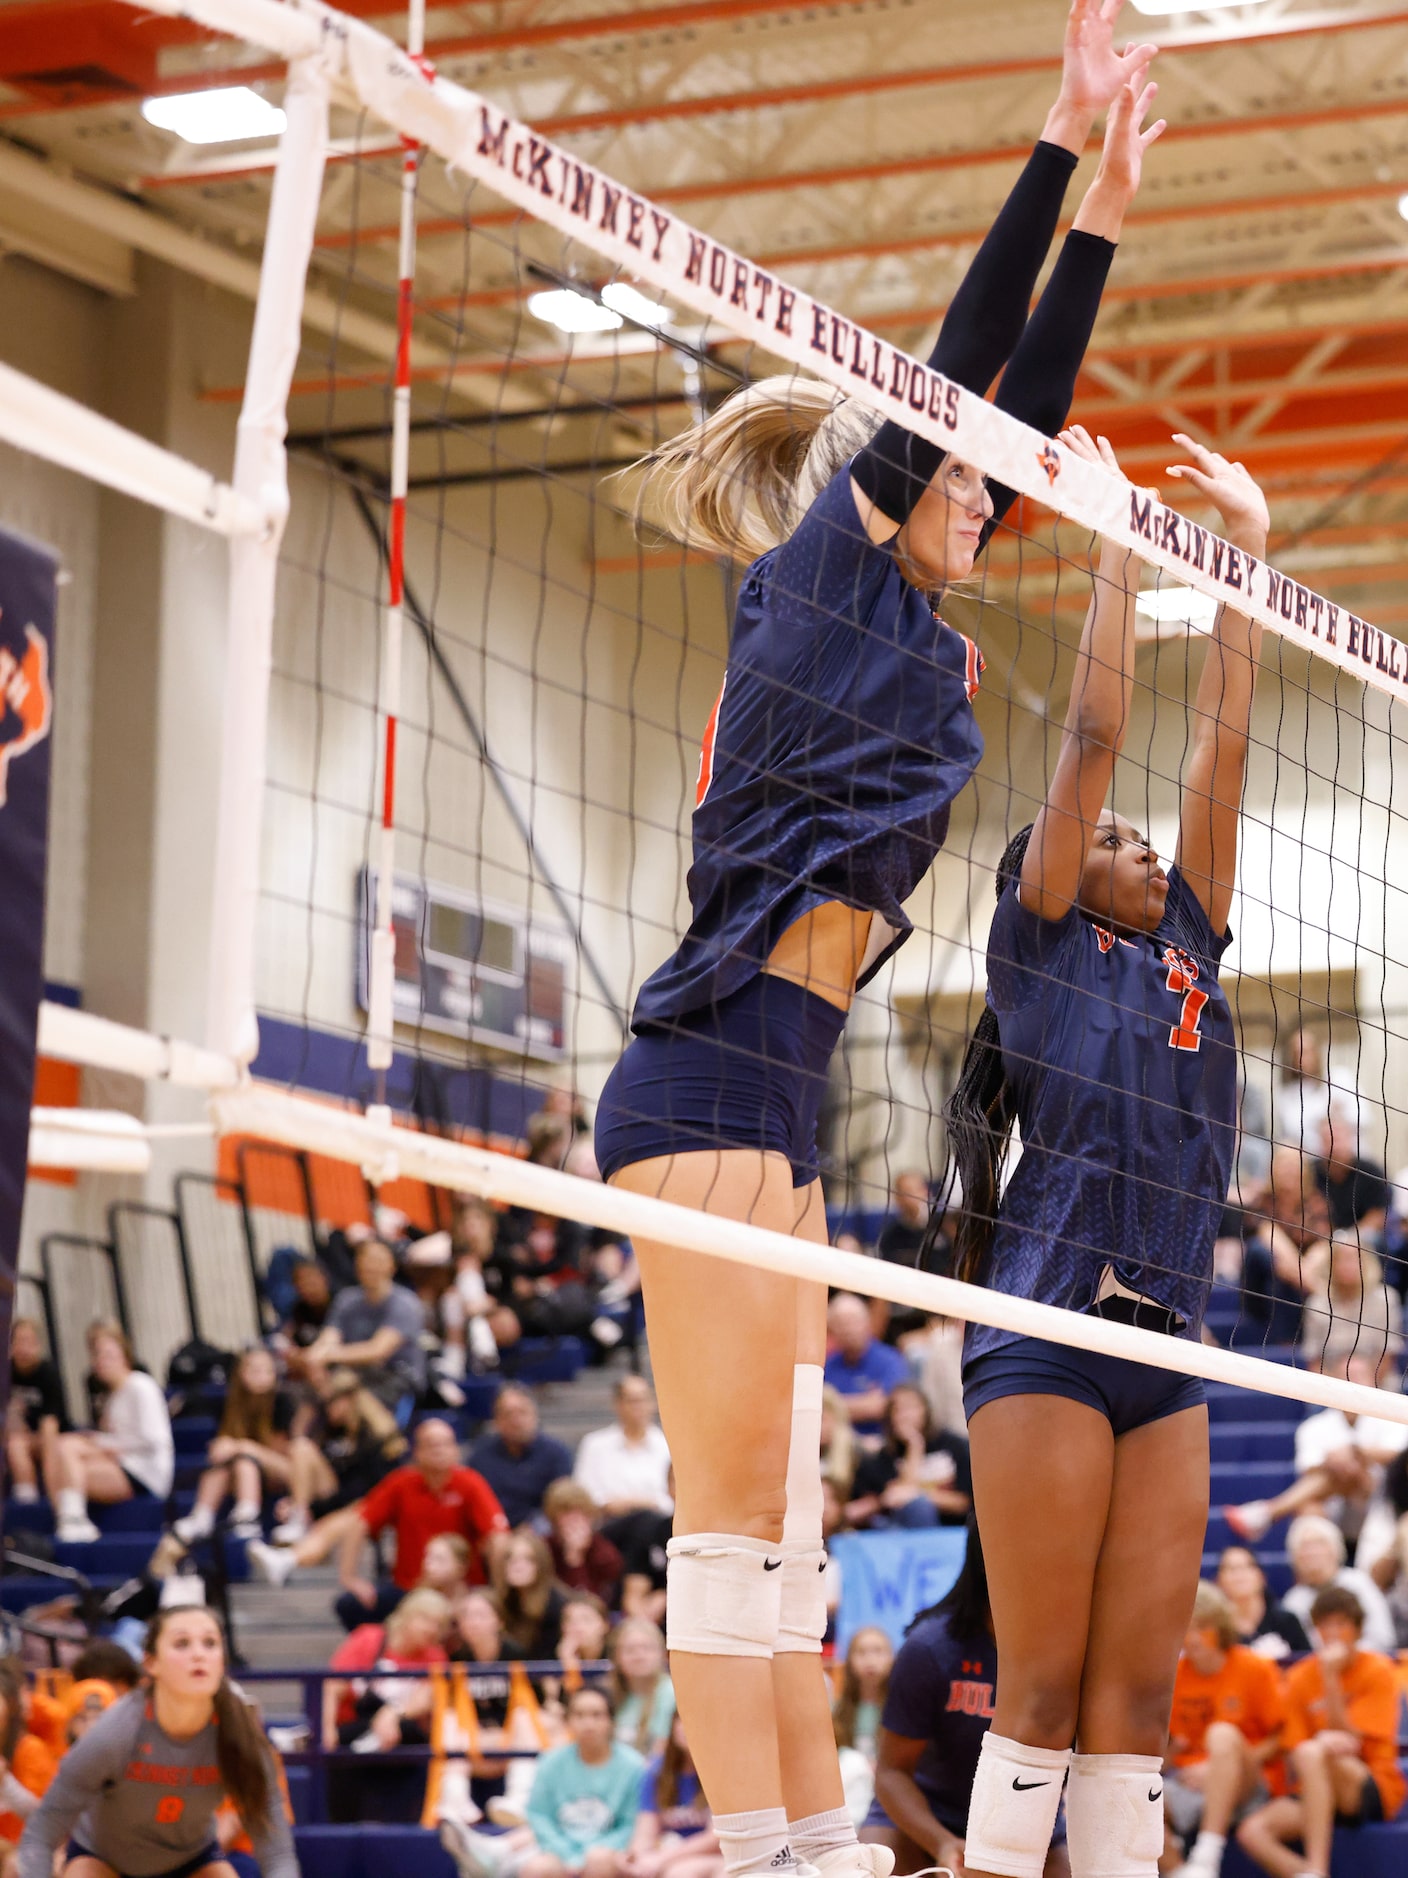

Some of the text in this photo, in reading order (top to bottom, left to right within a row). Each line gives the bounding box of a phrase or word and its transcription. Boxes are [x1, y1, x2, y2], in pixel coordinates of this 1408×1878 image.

[476, 106, 961, 432] McKINNEY NORTH BULLDOGS
[1130, 488, 1257, 597] McKINNEY
[1266, 566, 1339, 646] NORTH
[1165, 967, 1209, 1052] 7
